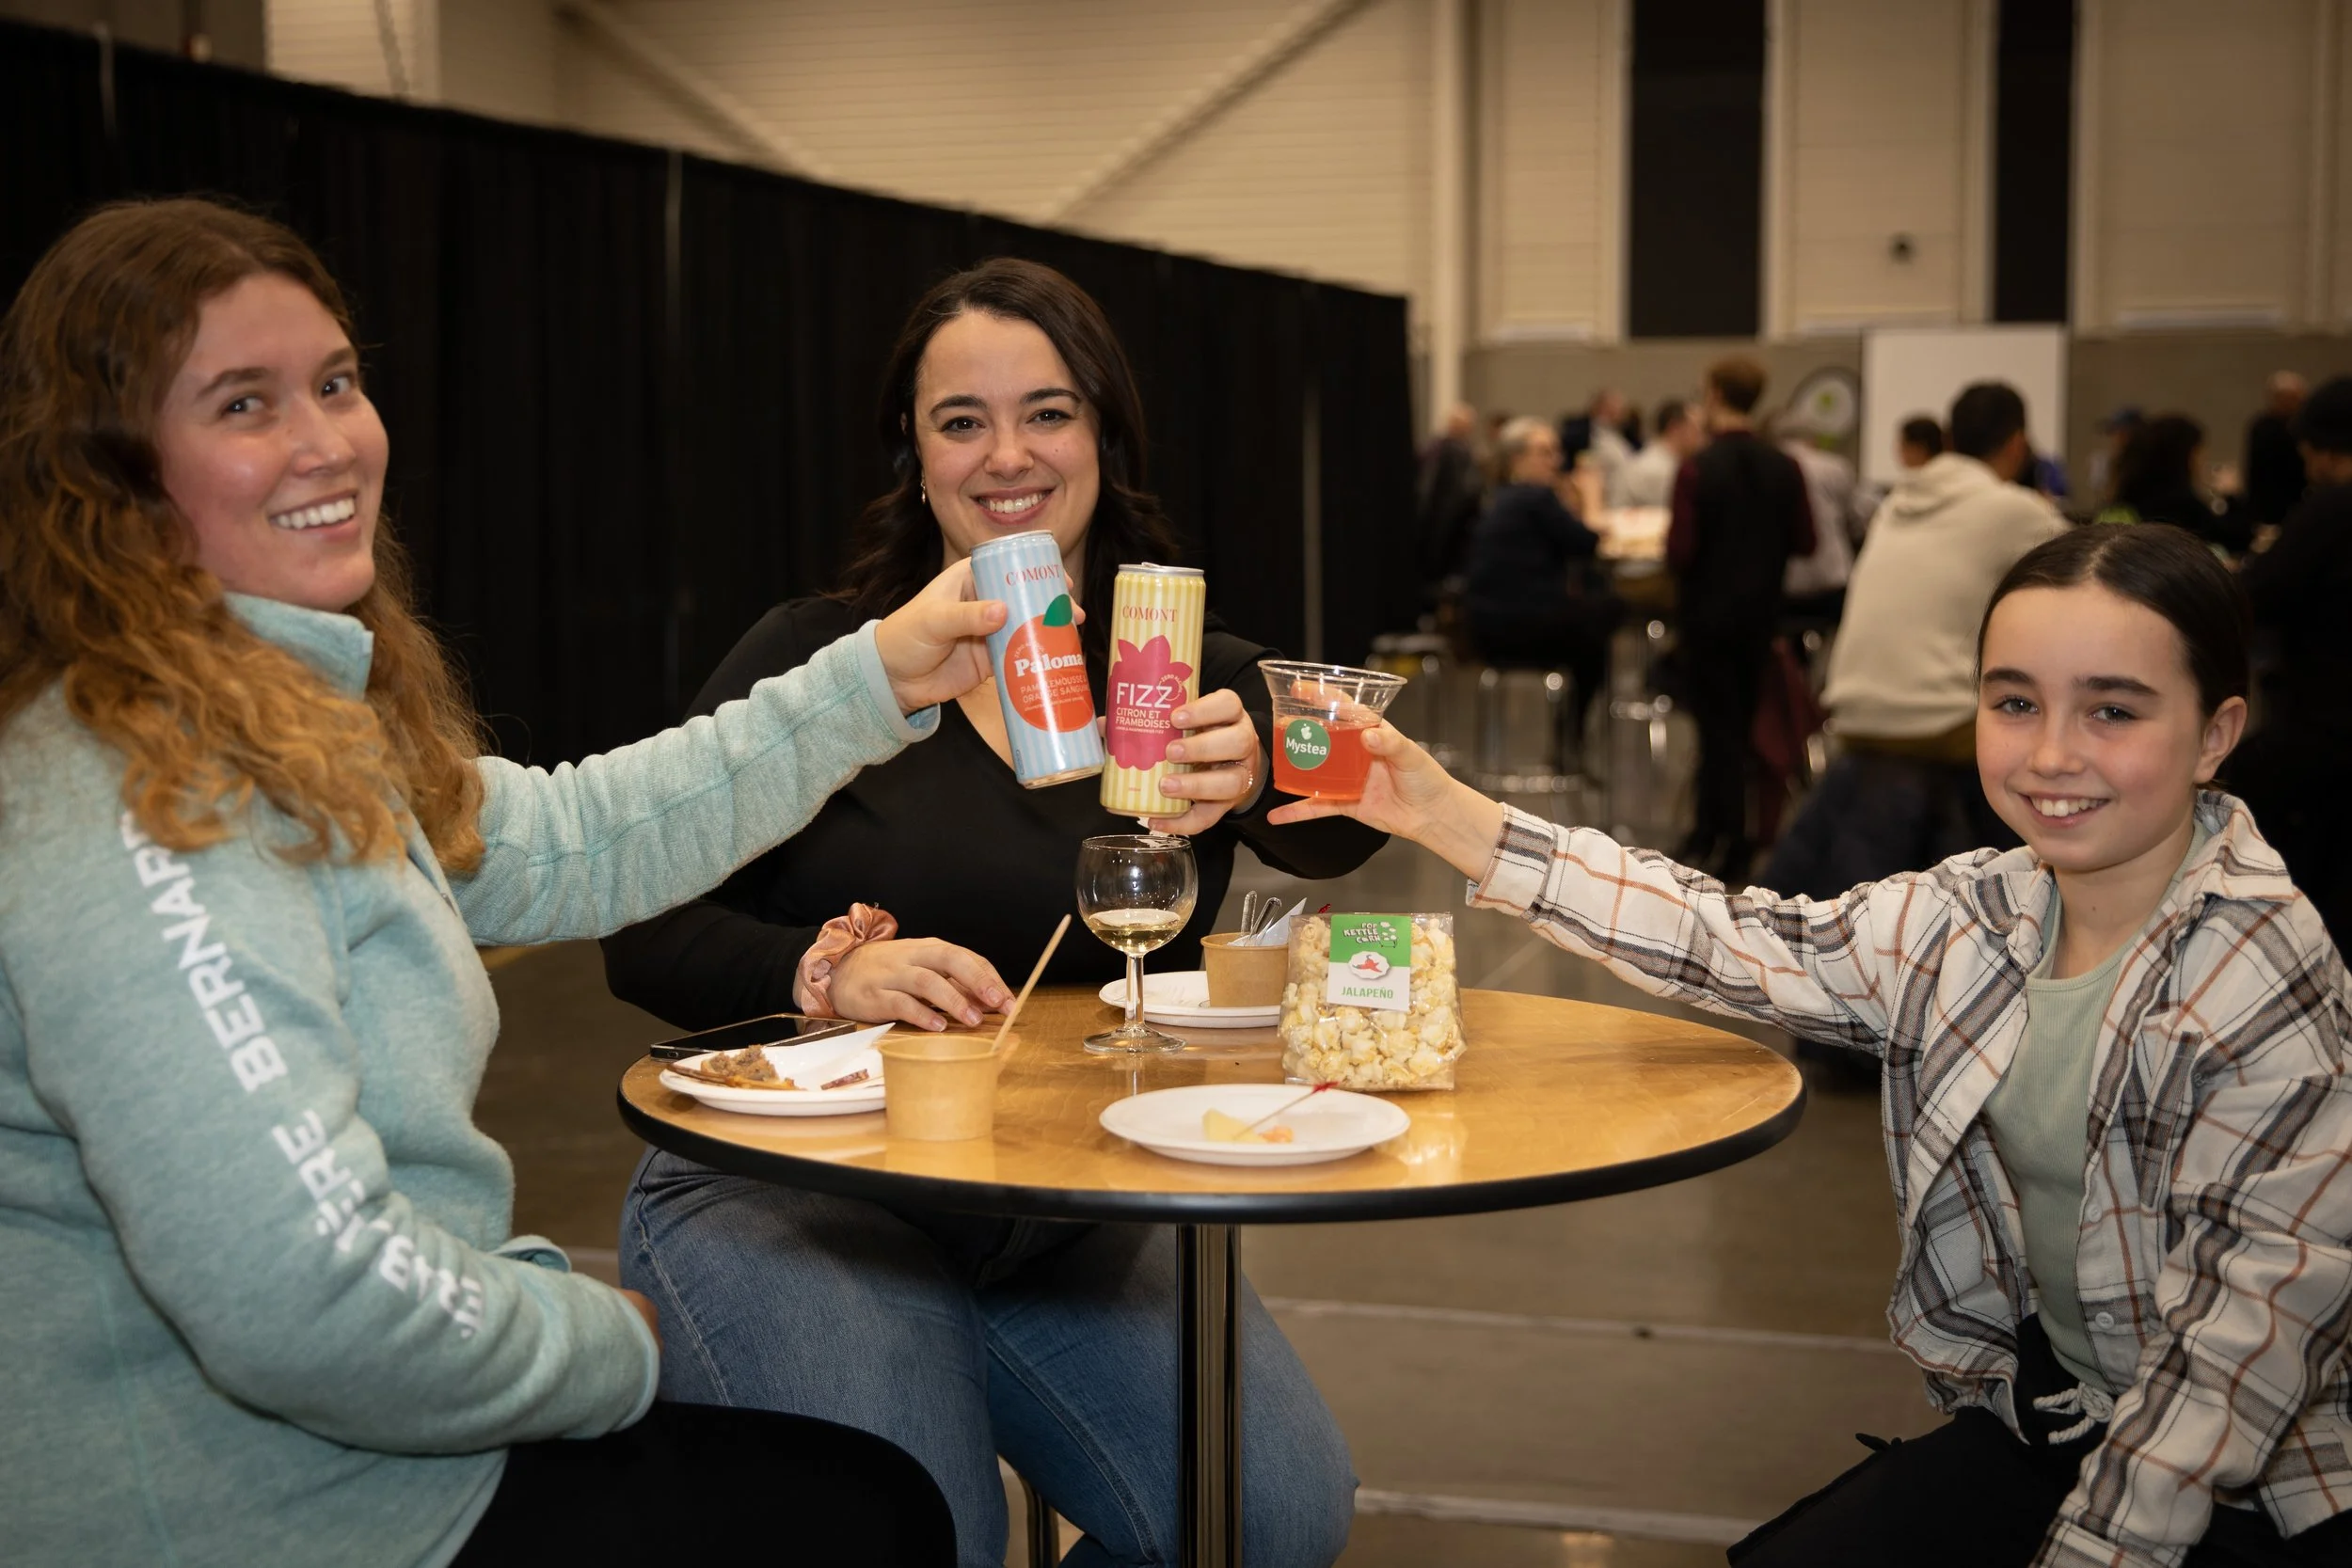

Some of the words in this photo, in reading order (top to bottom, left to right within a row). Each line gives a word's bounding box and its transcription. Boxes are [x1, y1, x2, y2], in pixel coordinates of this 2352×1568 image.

[1006, 564, 1061, 586] COMONT
[1121, 605, 1178, 623] COMONT
[1014, 652, 1084, 677] Paloma
[1020, 674, 1083, 694] PAMLEMOUSSE
[1023, 689, 1059, 704] ORAGE
[1116, 681, 1173, 709] FIZZ
[1116, 706, 1147, 719] CITRON
[1148, 710, 1162, 720] ET
[1115, 715, 1171, 730] FRAMBOISES
[1285, 736, 1327, 756] Mystea
[1343, 927, 1379, 937] KETTLE
[1356, 934, 1381, 943] CORN
[1341, 986, 1394, 1000] JALAPEÑO
